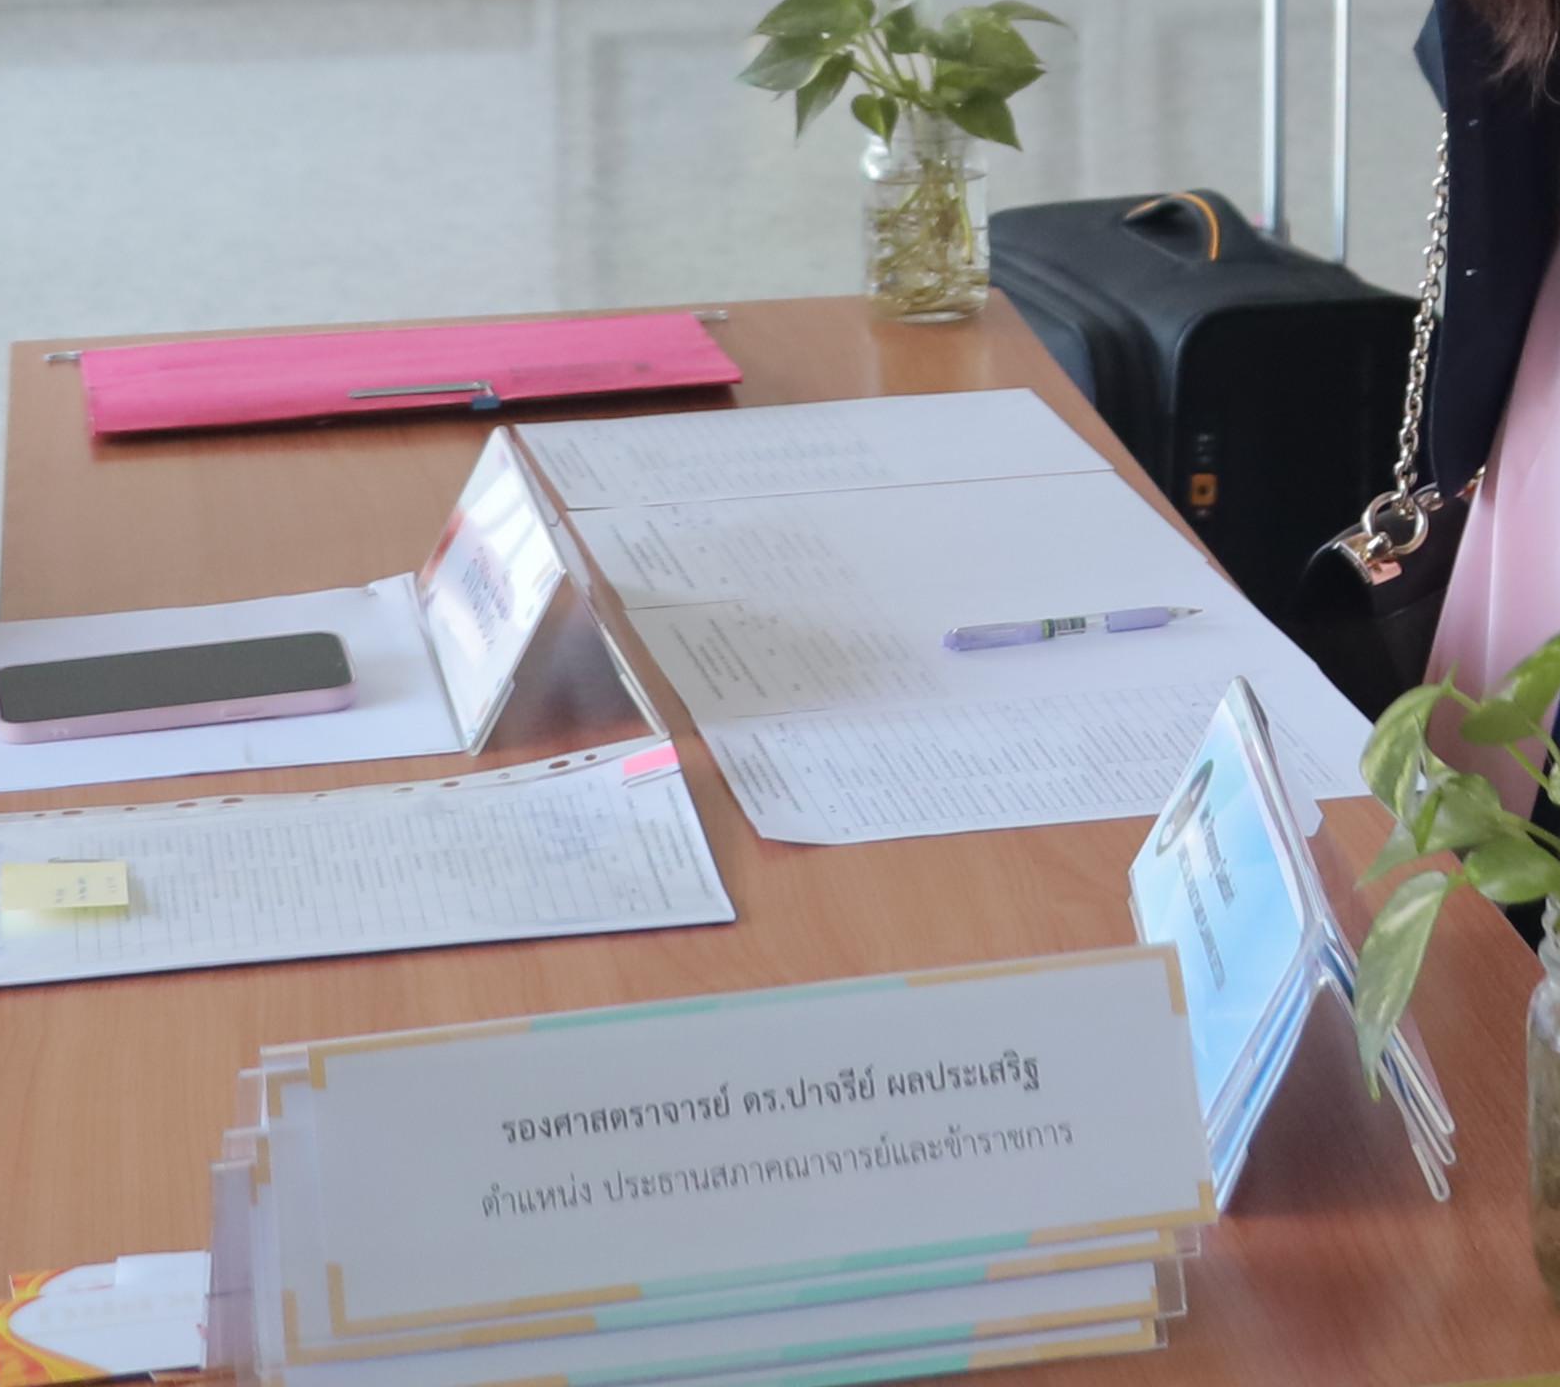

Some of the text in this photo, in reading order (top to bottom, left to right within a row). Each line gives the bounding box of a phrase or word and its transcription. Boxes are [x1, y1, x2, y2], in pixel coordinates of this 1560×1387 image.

[501, 1048, 1041, 1145] รองศาสตราจารย์ ดร.ปาจรีย์ ผลประเสริฐ
[480, 1172, 593, 1219] ตำแหน่ง
